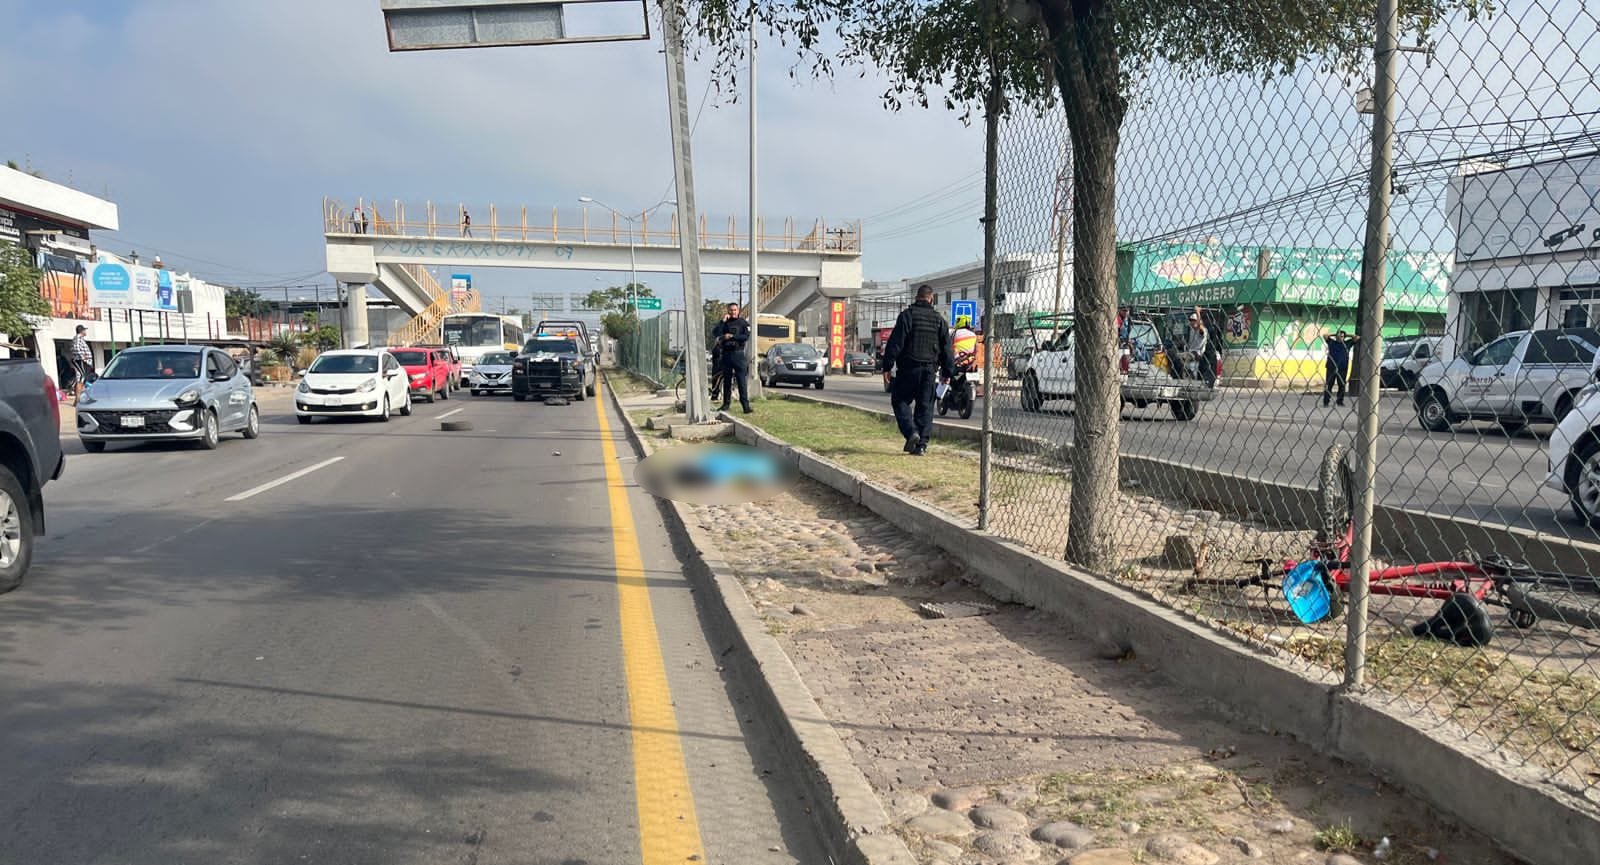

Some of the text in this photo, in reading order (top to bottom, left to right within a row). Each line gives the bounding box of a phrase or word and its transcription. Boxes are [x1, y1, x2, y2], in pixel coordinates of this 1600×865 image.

[1154, 292, 1171, 305] DEL
[1330, 286, 1337, 299] Y
[832, 302, 843, 368] BIRRIA
